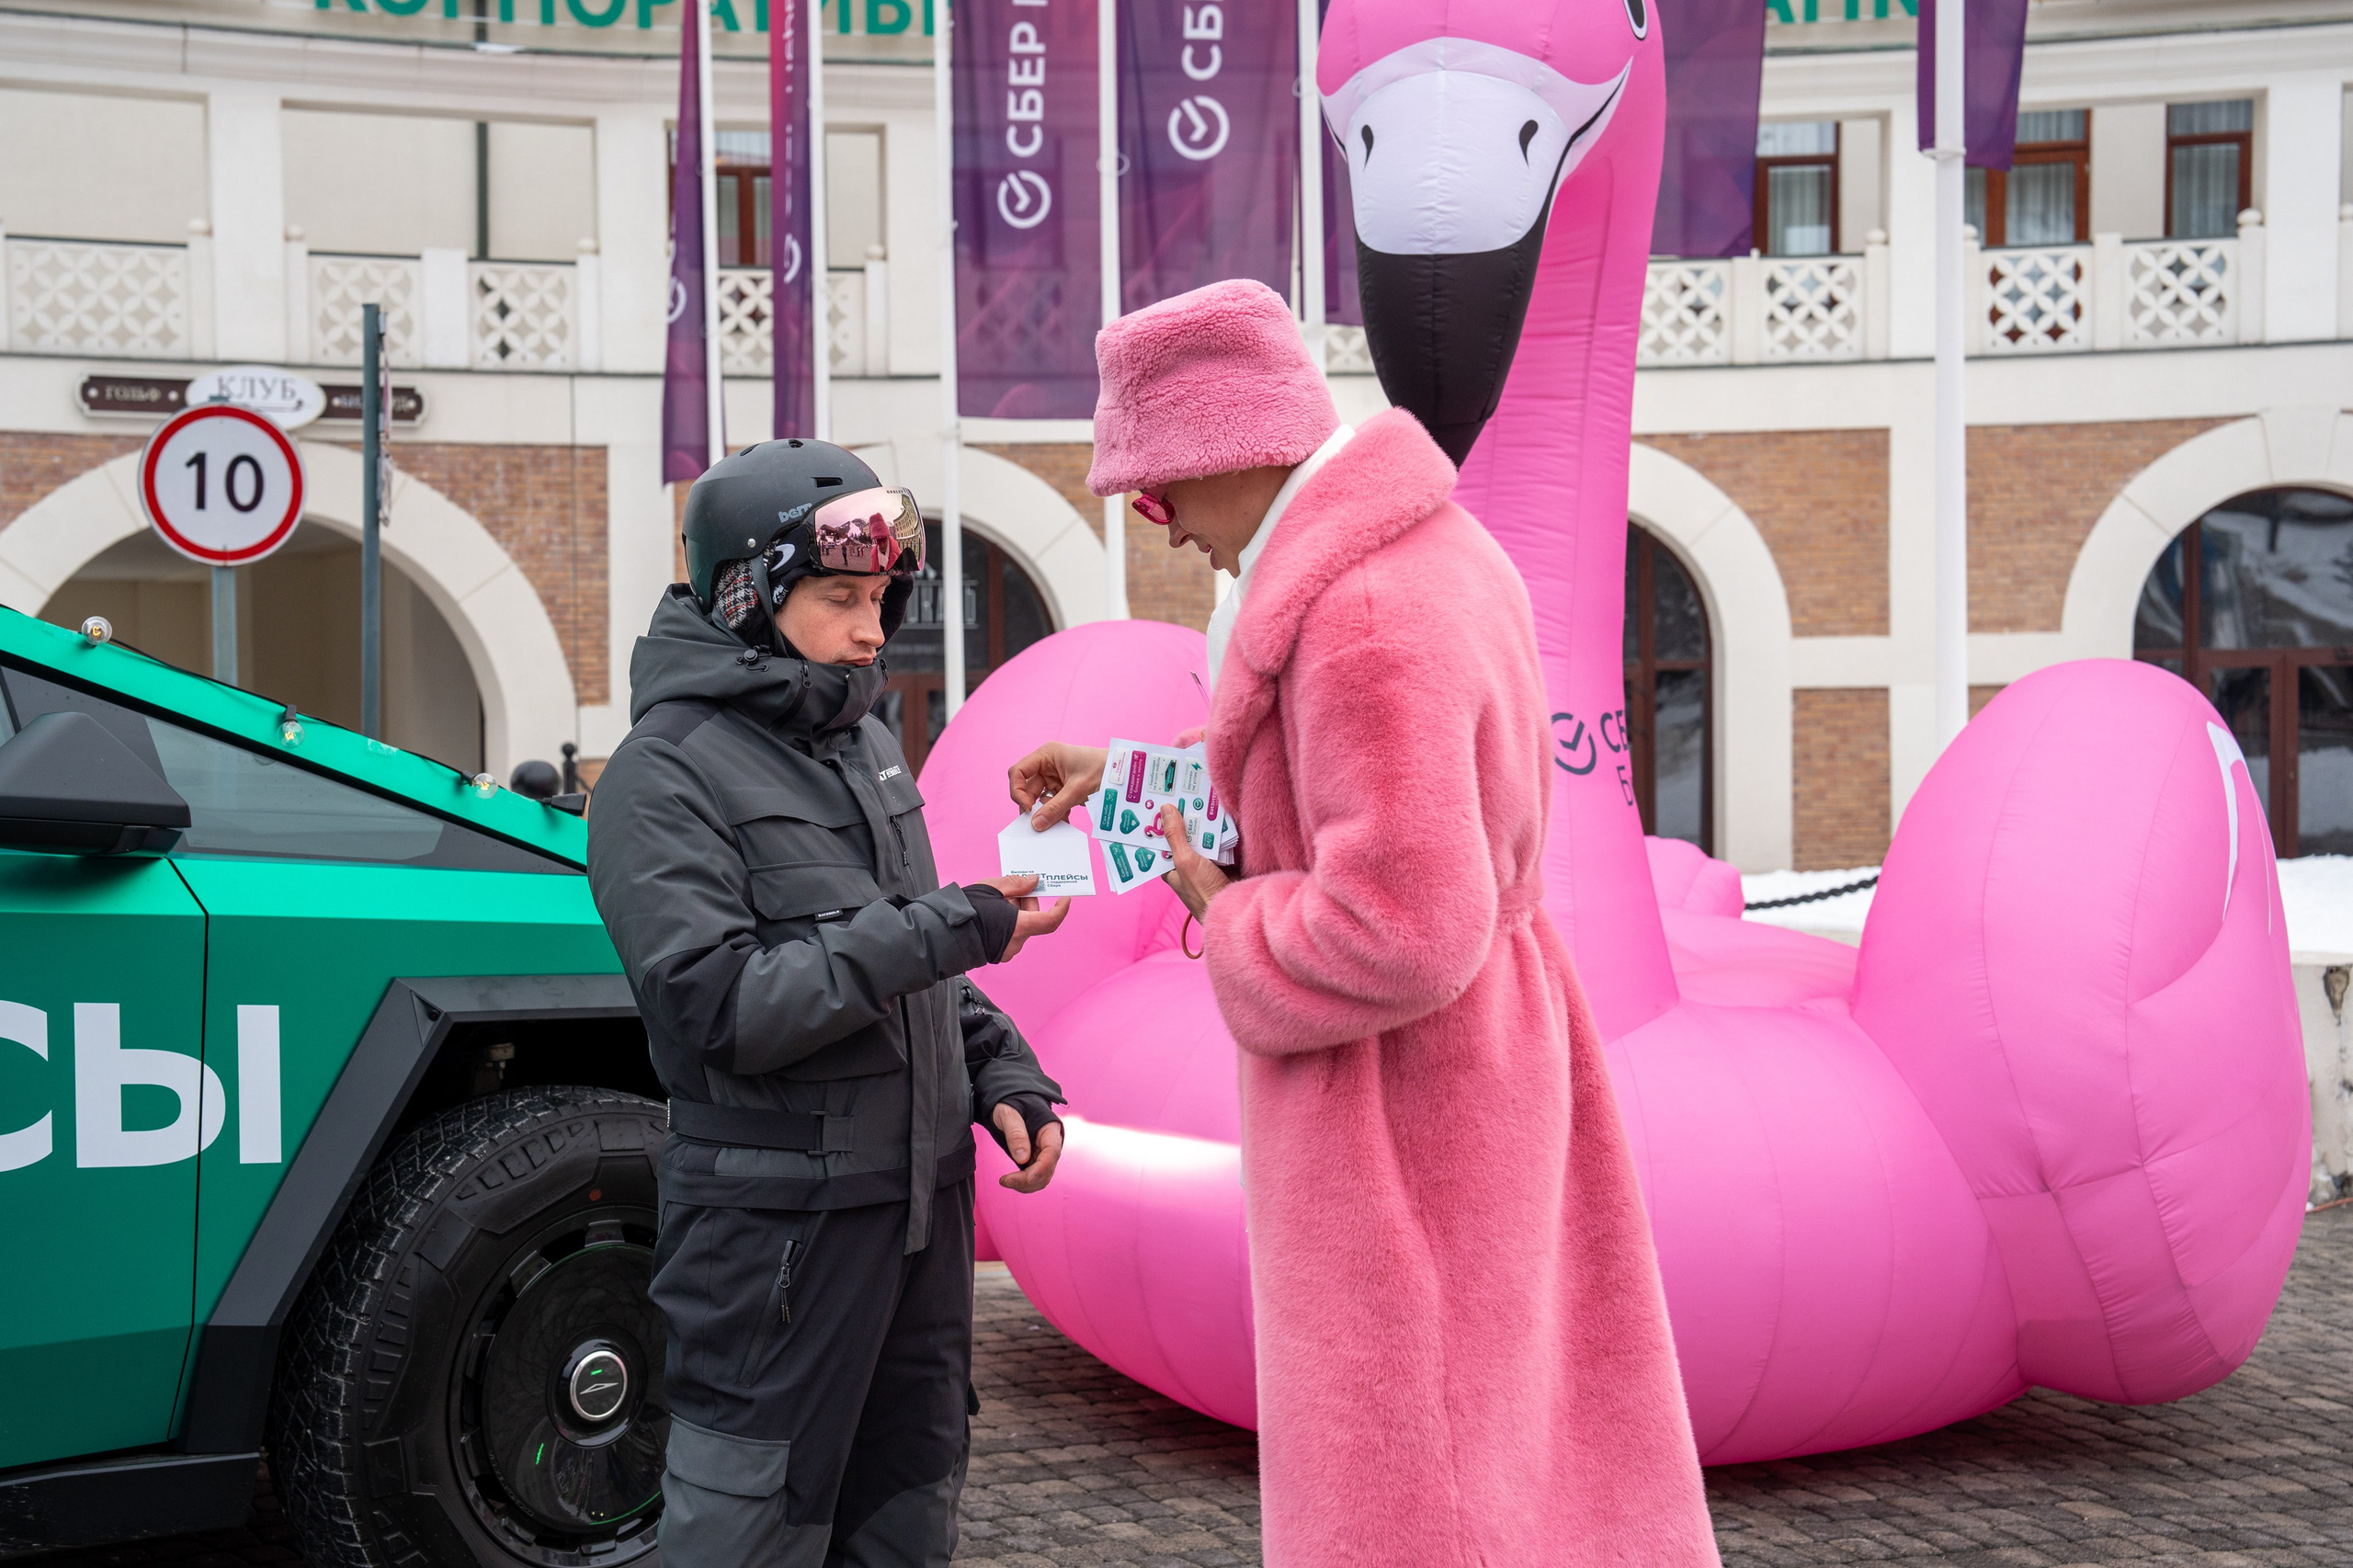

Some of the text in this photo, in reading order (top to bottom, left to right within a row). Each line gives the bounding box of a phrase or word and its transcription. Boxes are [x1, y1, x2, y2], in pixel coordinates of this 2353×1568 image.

[1181, 0, 1224, 81] СБ
[1006, 21, 1046, 158] СБЕР
[105, 385, 161, 402] ГОЛЬФ
[217, 377, 297, 401] КЛУБ
[186, 451, 264, 513] 10
